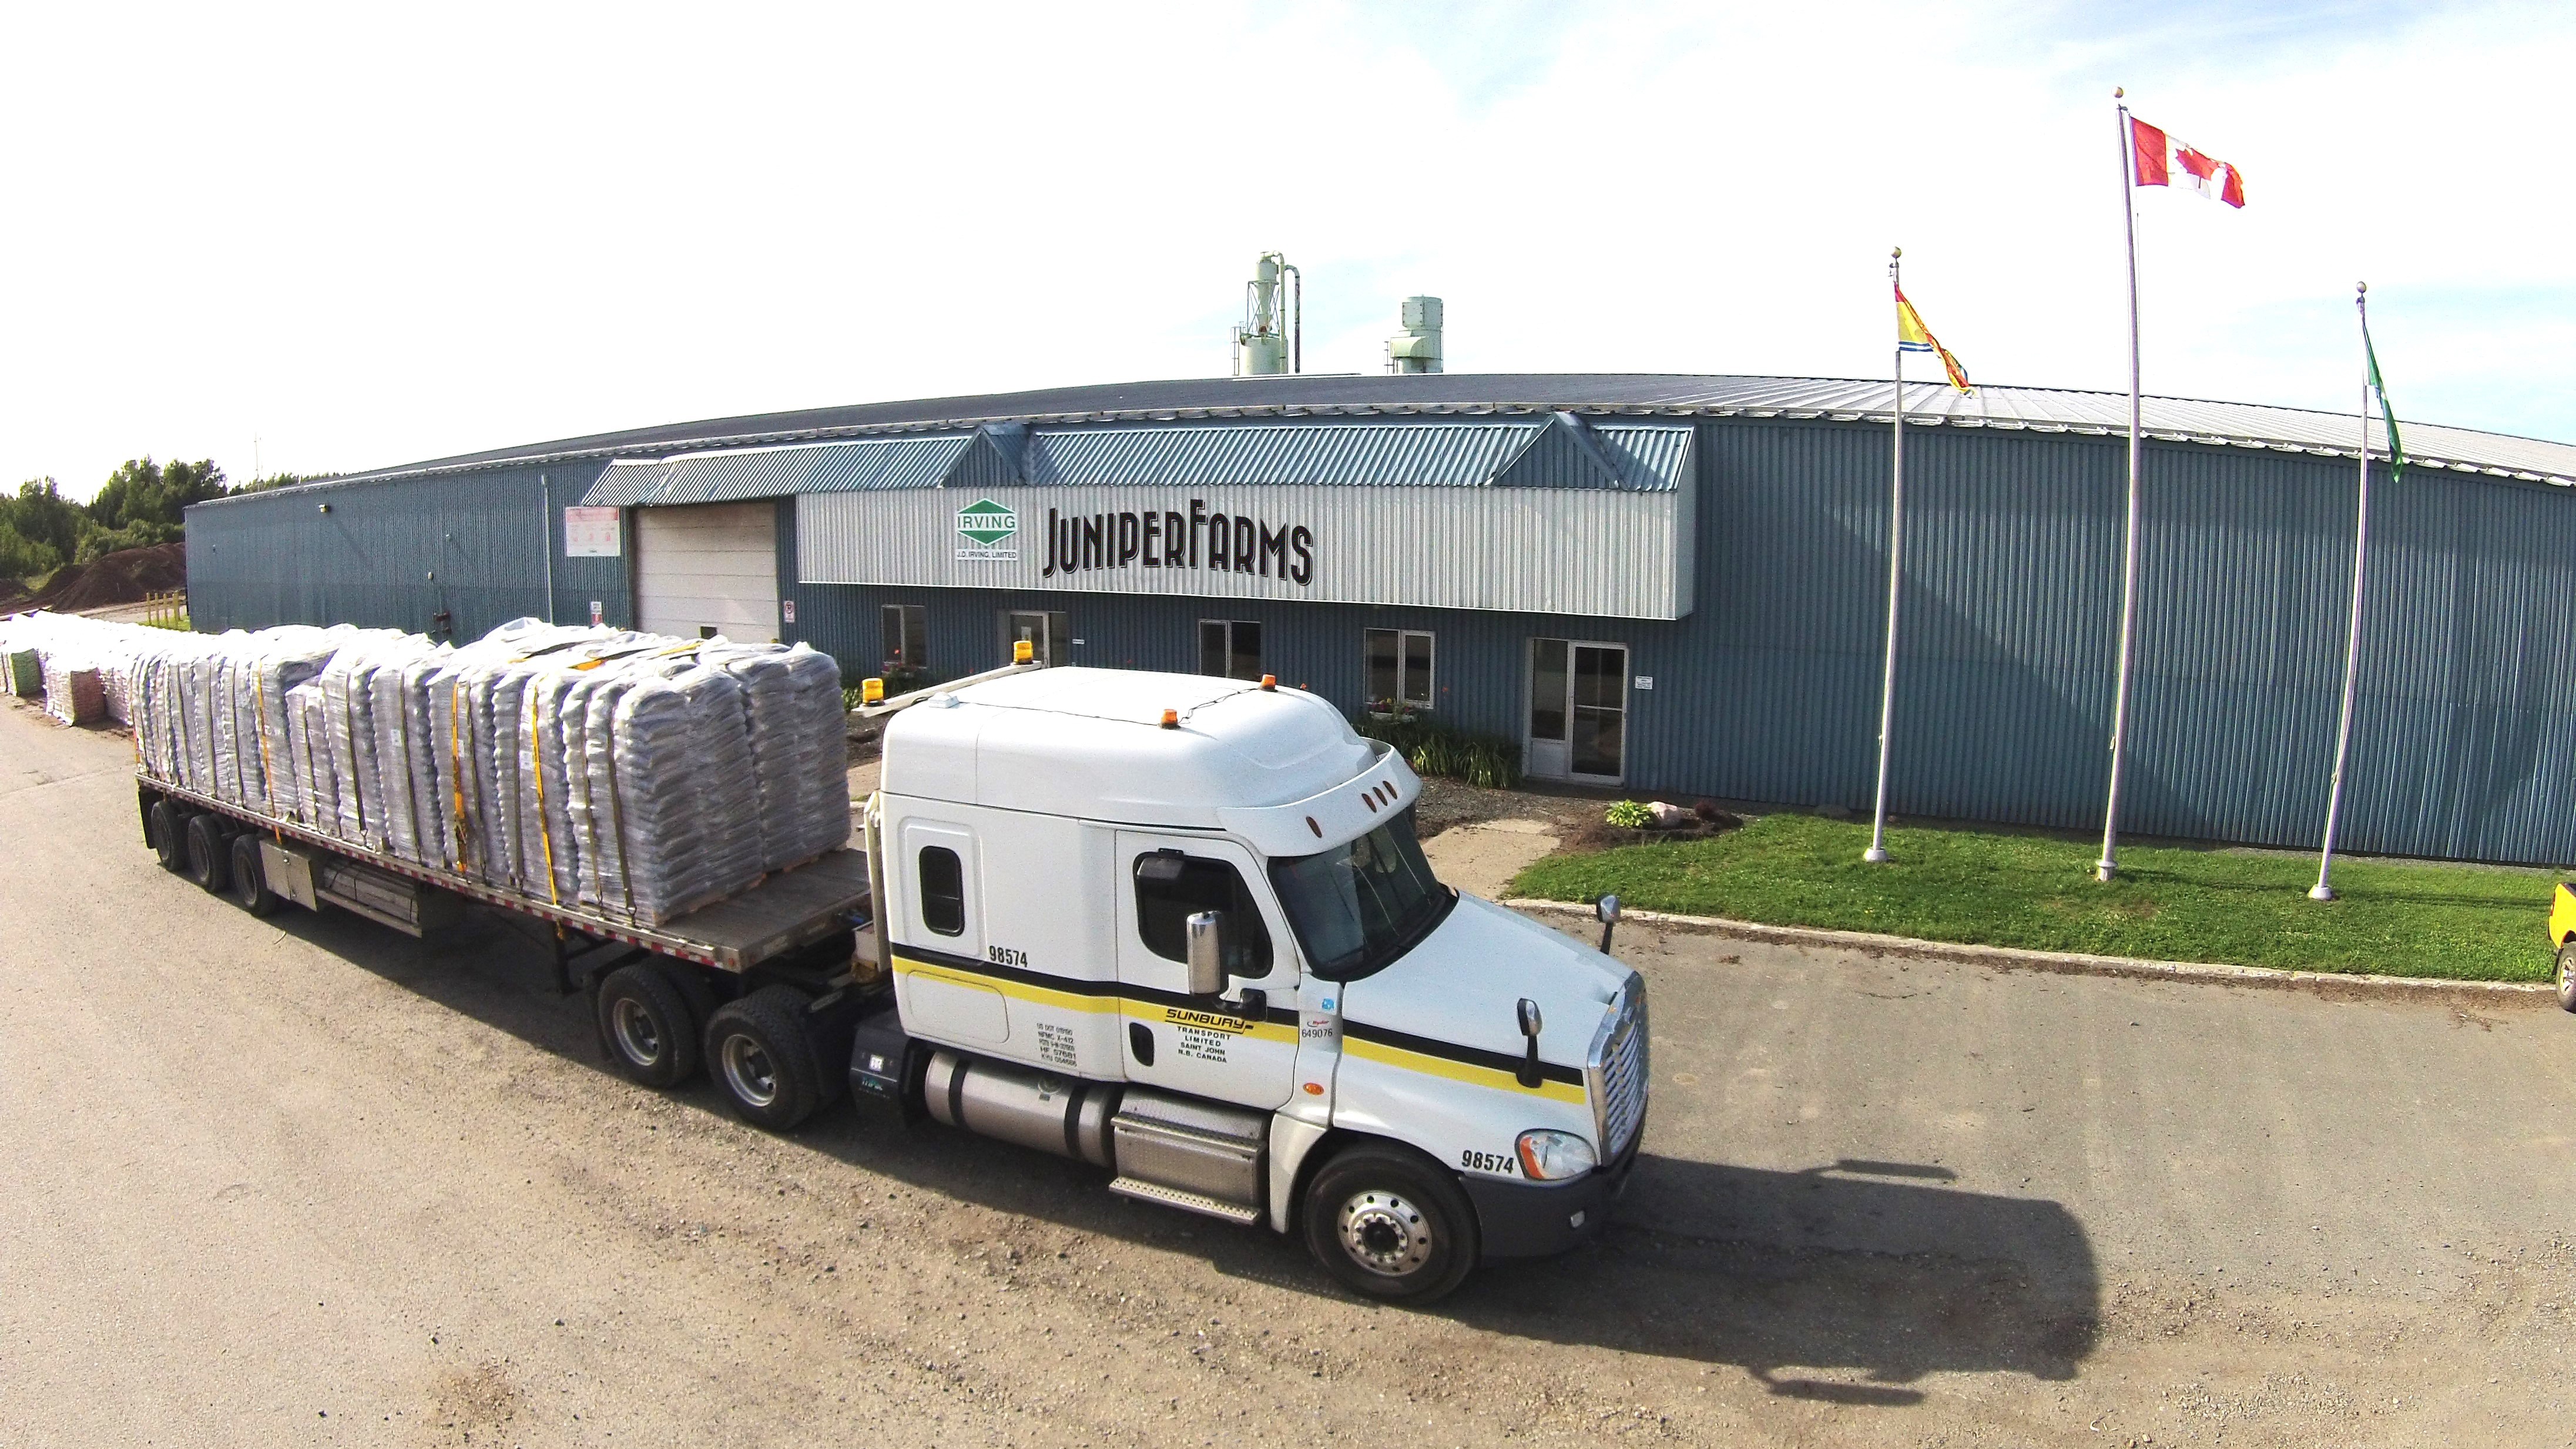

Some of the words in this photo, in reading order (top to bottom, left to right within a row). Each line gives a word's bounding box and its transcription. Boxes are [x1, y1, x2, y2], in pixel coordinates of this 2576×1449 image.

[957, 515, 1015, 528] IRVING
[989, 945, 1028, 968] 98574
[1166, 1008, 1245, 1029] SUNBURY
[1177, 1026, 1232, 1041] TRANSPORT
[1302, 1028, 1333, 1038] 649076
[1185, 1035, 1221, 1047] LIMITED
[1180, 1042, 1202, 1052] SAINT
[1205, 1046, 1226, 1056] JOHN
[1196, 1052, 1227, 1064] CANADA
[1461, 1149, 1514, 1174] 98574
